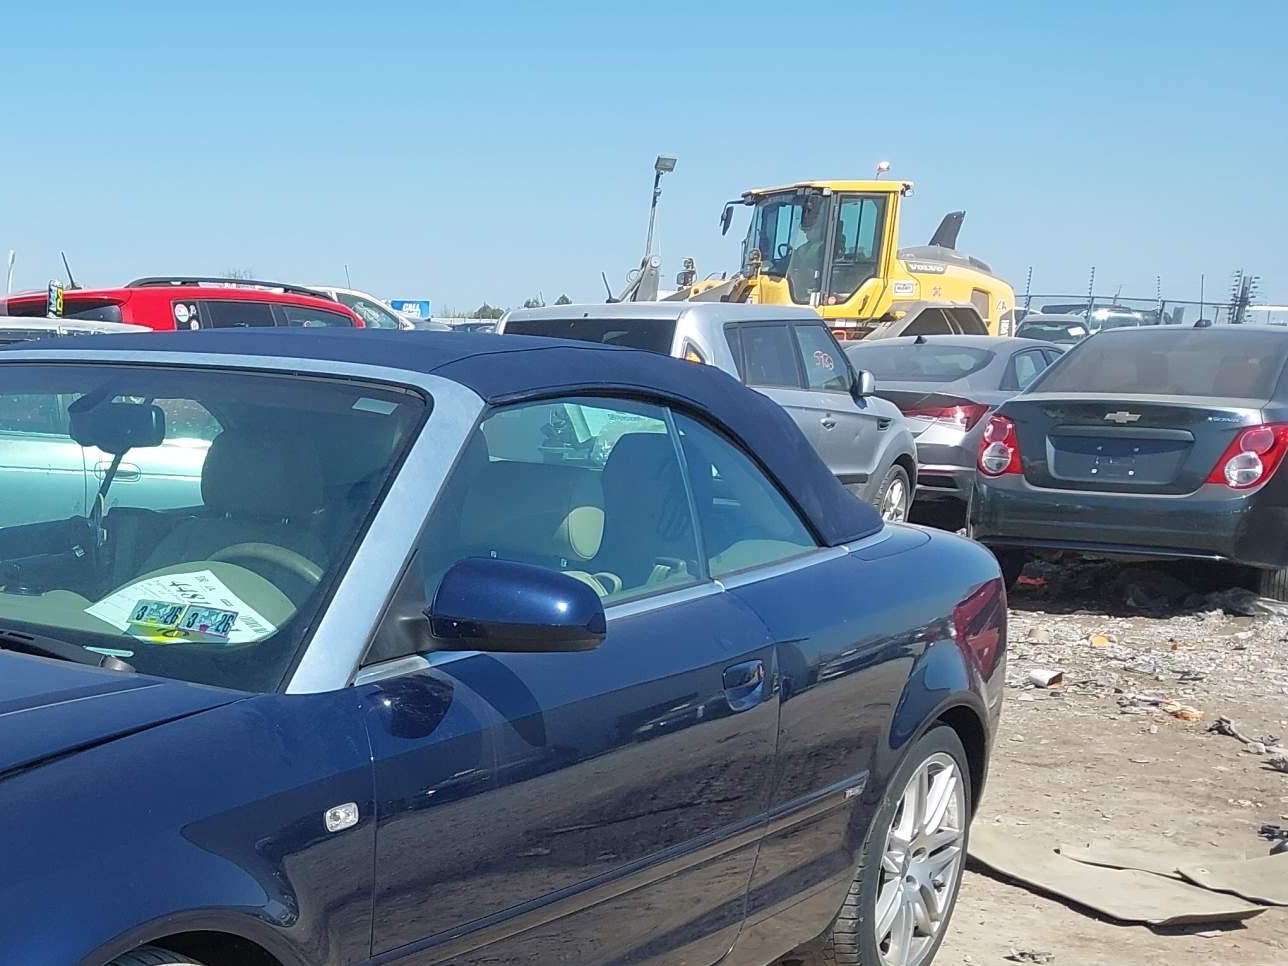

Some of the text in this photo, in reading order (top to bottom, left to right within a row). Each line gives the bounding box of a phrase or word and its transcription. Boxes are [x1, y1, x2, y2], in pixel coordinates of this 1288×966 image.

[908, 263, 944, 273] VOLVO
[135, 605, 183, 625] 3 26
[186, 612, 199, 628] 3
[215, 613, 235, 633] 26
